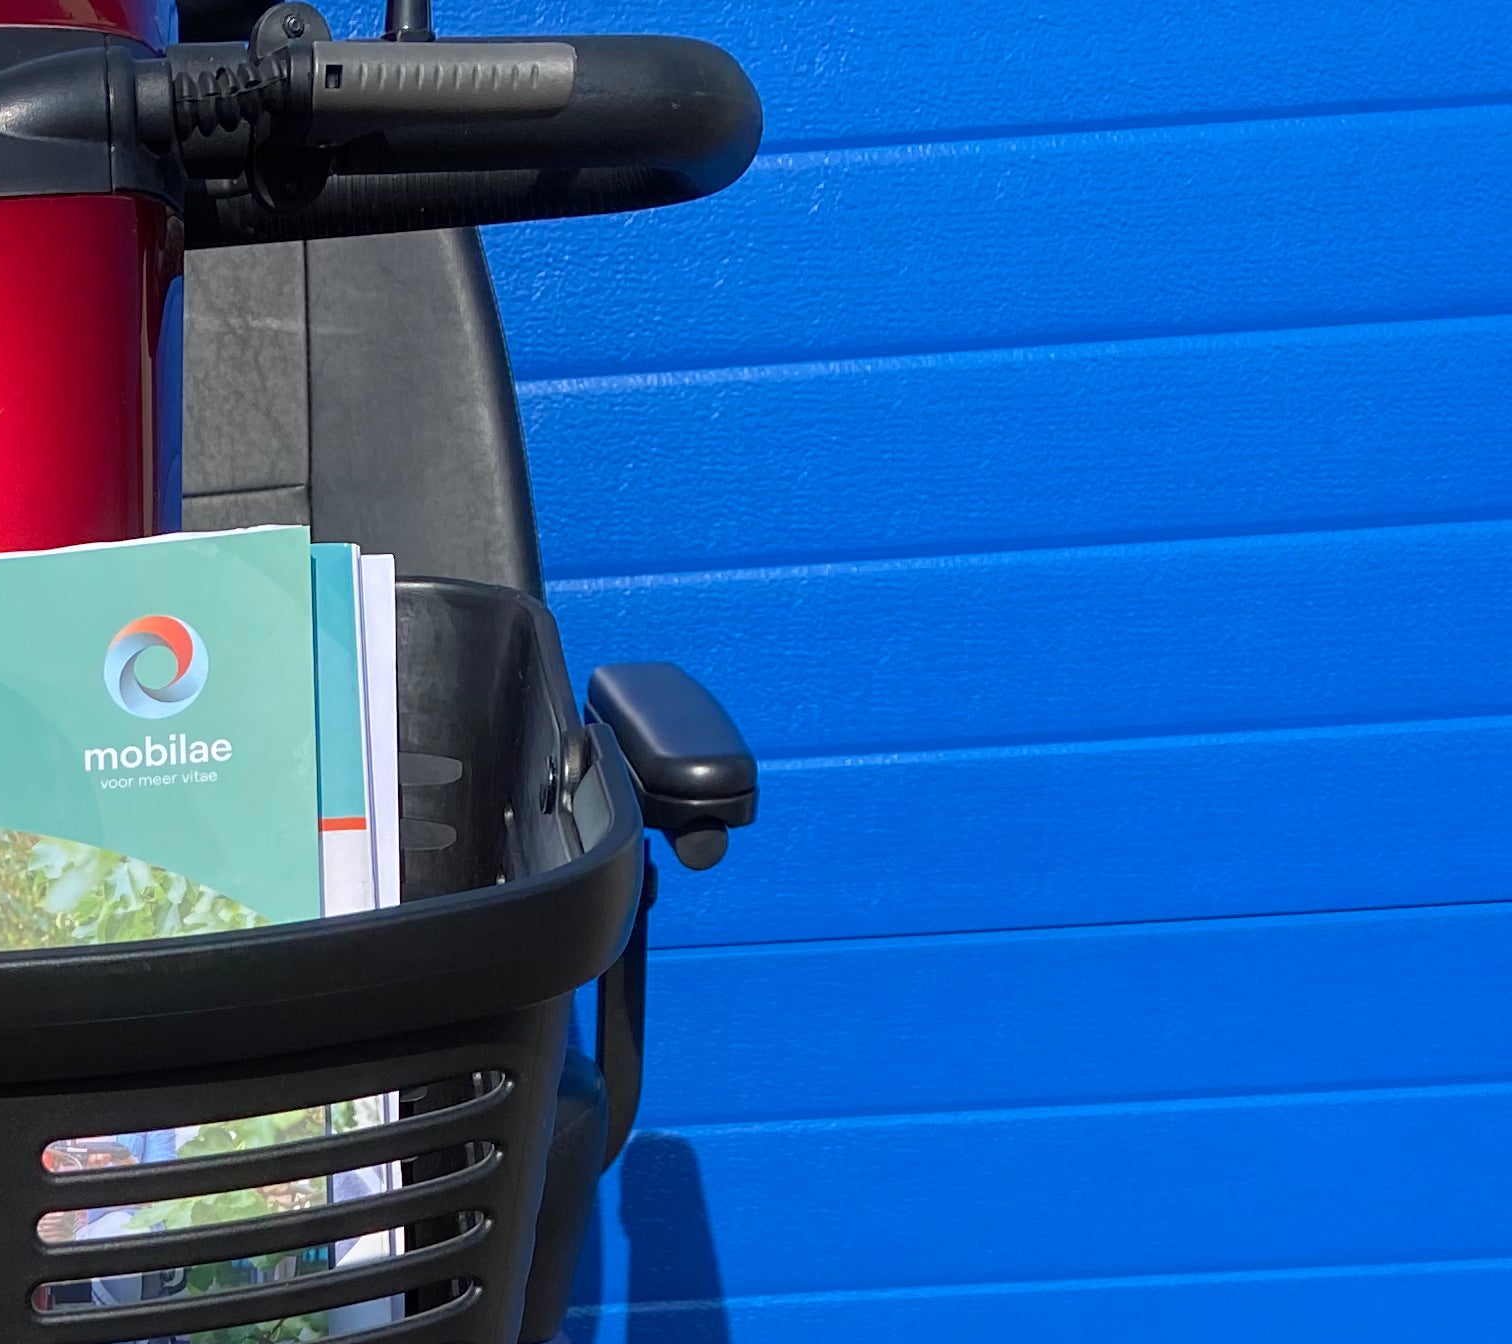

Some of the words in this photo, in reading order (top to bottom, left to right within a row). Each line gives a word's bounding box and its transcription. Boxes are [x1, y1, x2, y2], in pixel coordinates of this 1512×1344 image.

[84, 733, 233, 771] mobilae
[100, 775, 134, 790] voor
[138, 772, 178, 787] meer
[181, 769, 218, 785] vitae
